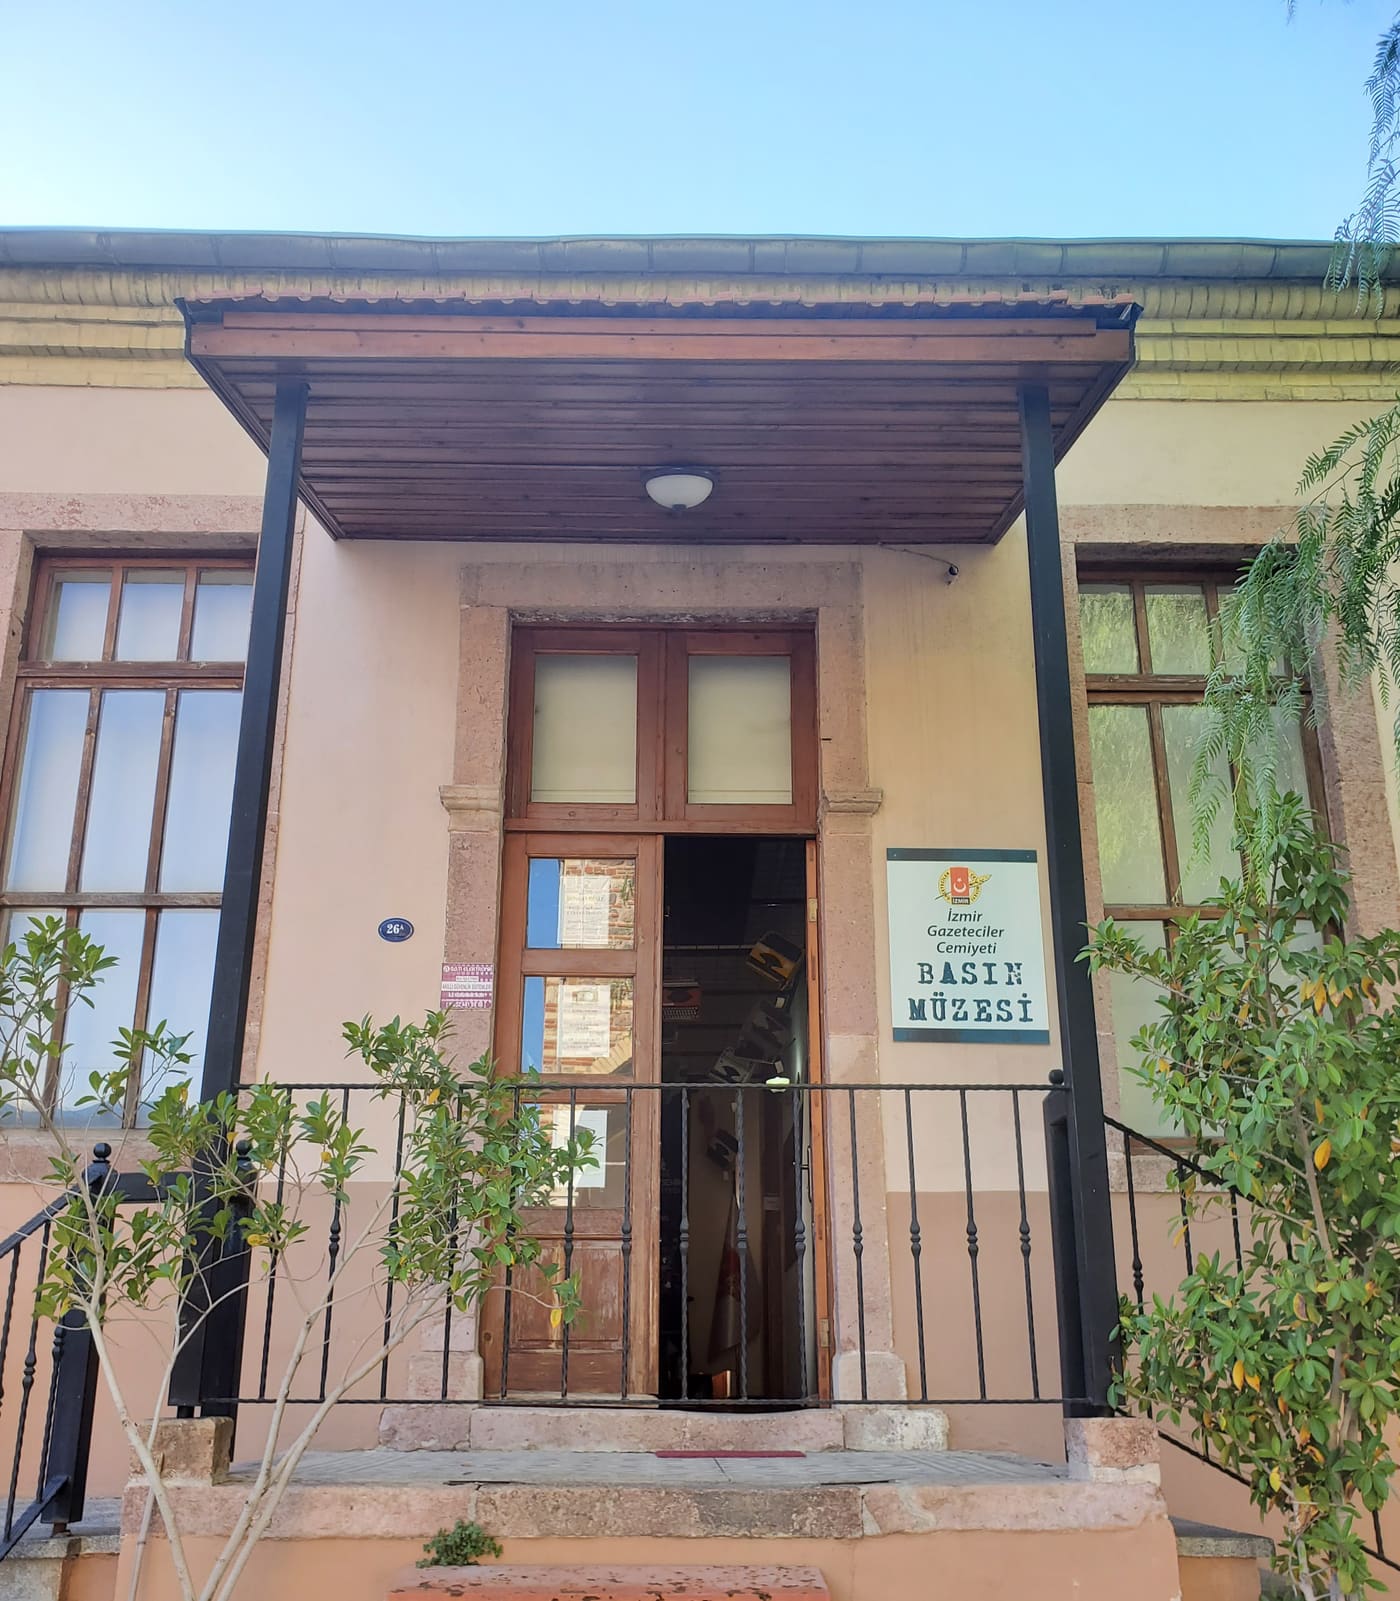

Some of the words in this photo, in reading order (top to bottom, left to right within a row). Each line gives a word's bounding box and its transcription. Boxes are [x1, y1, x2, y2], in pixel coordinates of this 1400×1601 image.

[947, 907, 983, 922] İzmir
[927, 925, 1005, 938] Gazeteciler
[936, 941, 997, 957] Cemiyeti
[917, 961, 1023, 986] BASIN
[908, 991, 1034, 1023] MÜZESİ
